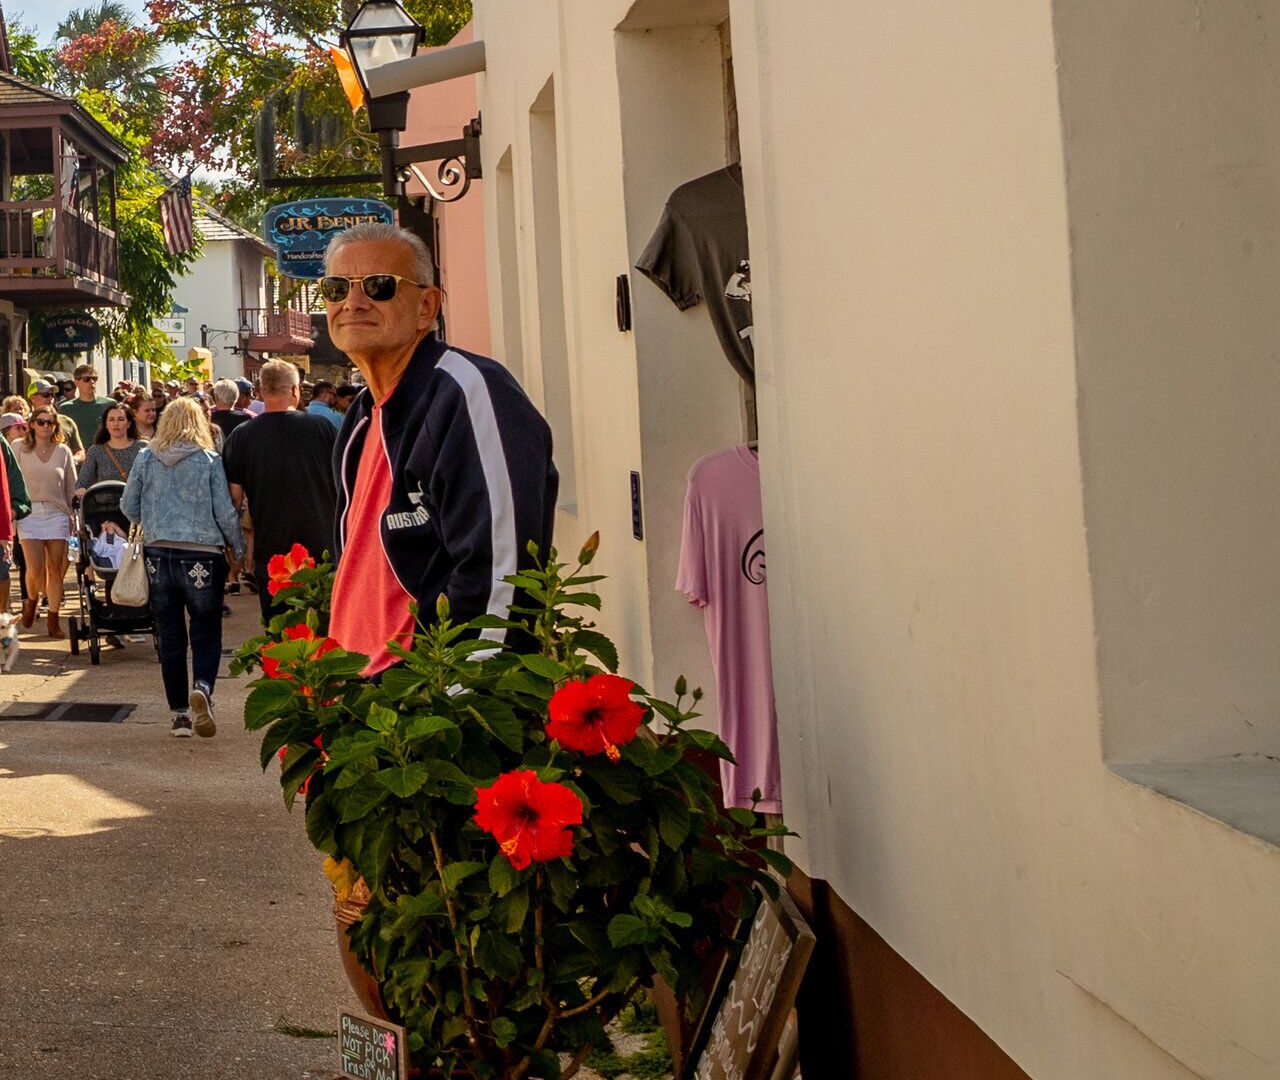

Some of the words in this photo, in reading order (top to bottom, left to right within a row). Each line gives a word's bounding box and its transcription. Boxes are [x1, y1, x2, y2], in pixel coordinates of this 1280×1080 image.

[287, 251, 327, 260] Handcrafted
[342, 1016, 370, 1040] Please
[343, 1034, 362, 1053] NOT
[365, 1041, 390, 1069] PICK
[342, 1054, 371, 1080] Trash
